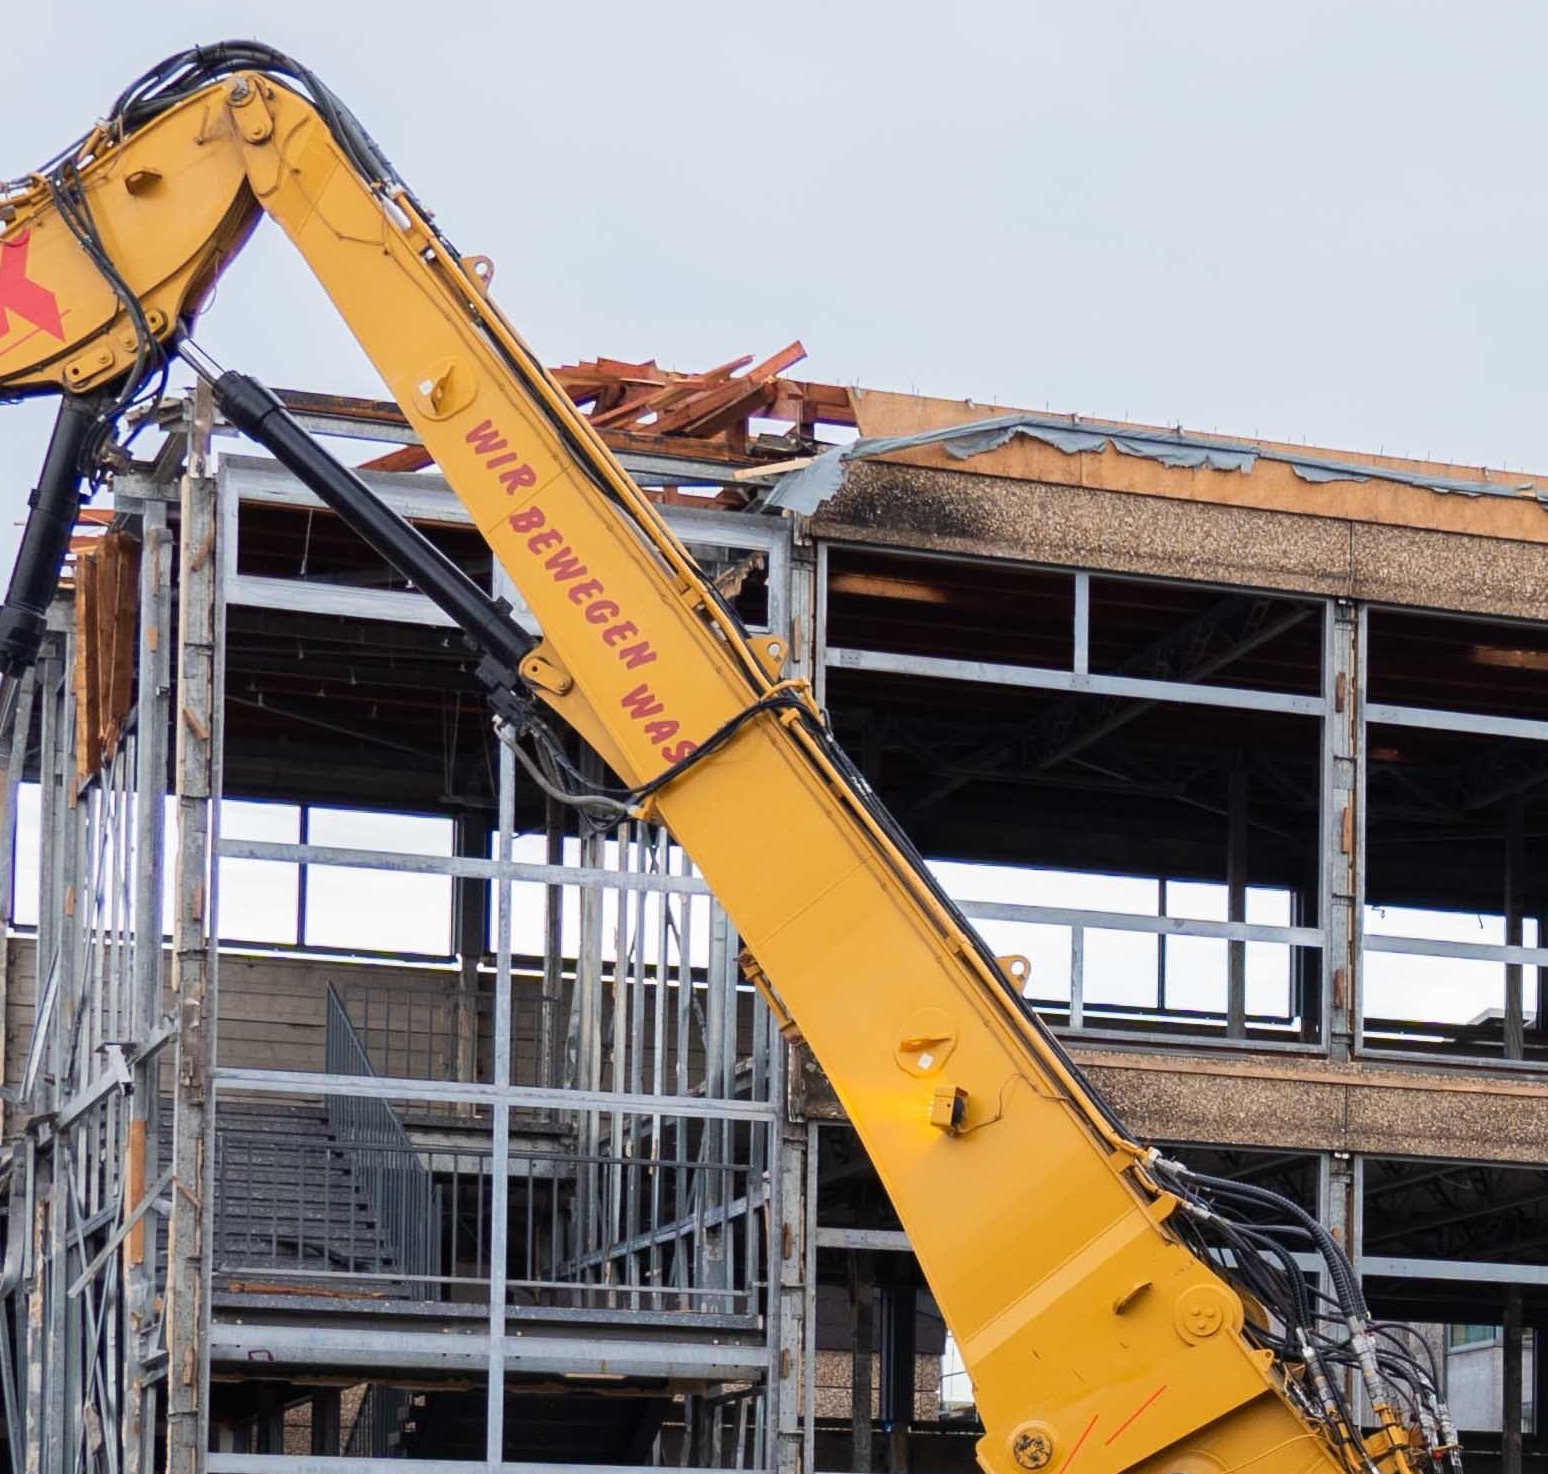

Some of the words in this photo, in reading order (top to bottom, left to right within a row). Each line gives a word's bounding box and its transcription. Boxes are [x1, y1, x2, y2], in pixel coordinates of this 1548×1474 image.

[465, 419, 537, 495] WIR
[508, 505, 657, 671] BEWEGEN
[621, 683, 698, 764] WAS
